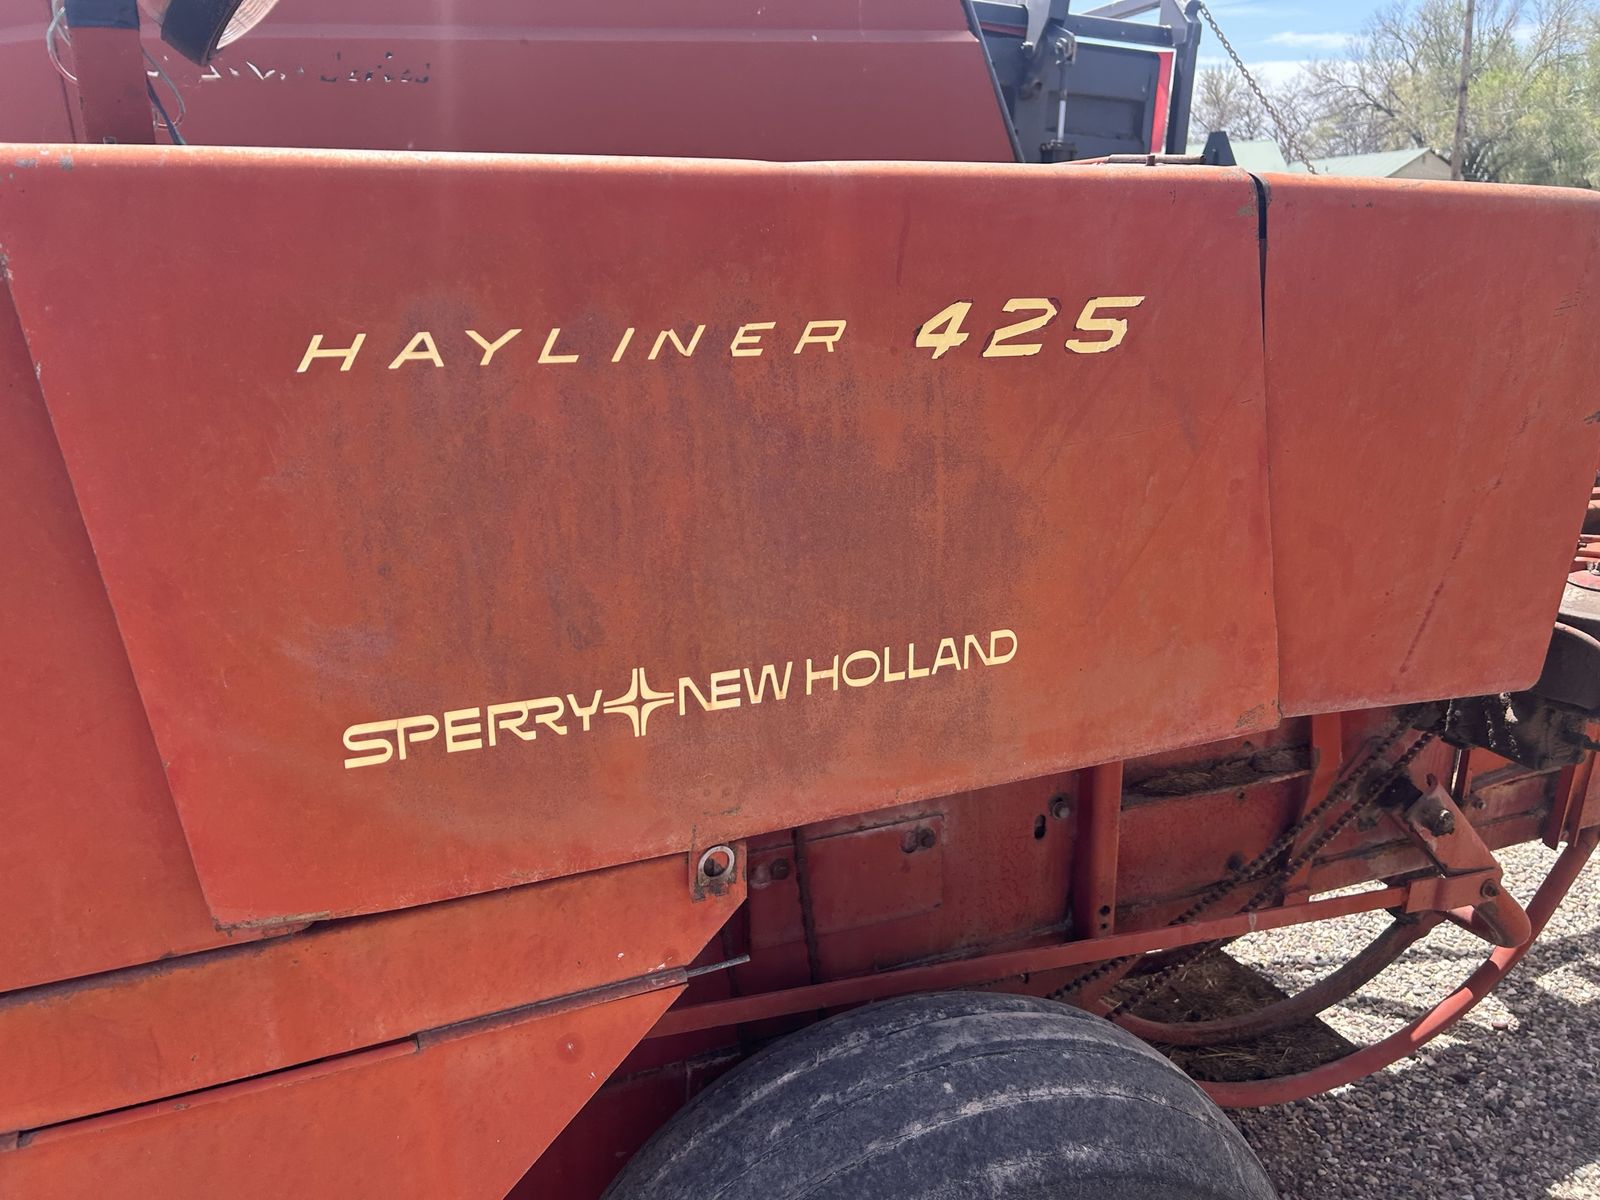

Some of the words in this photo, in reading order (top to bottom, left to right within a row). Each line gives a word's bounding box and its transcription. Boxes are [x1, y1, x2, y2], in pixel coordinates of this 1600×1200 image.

[297, 320, 847, 373] HAYLINER
[915, 296, 1146, 359] 425
[343, 689, 603, 769] SPERRY
[678, 661, 793, 716] NEW
[806, 629, 1018, 695] HOLLAND
